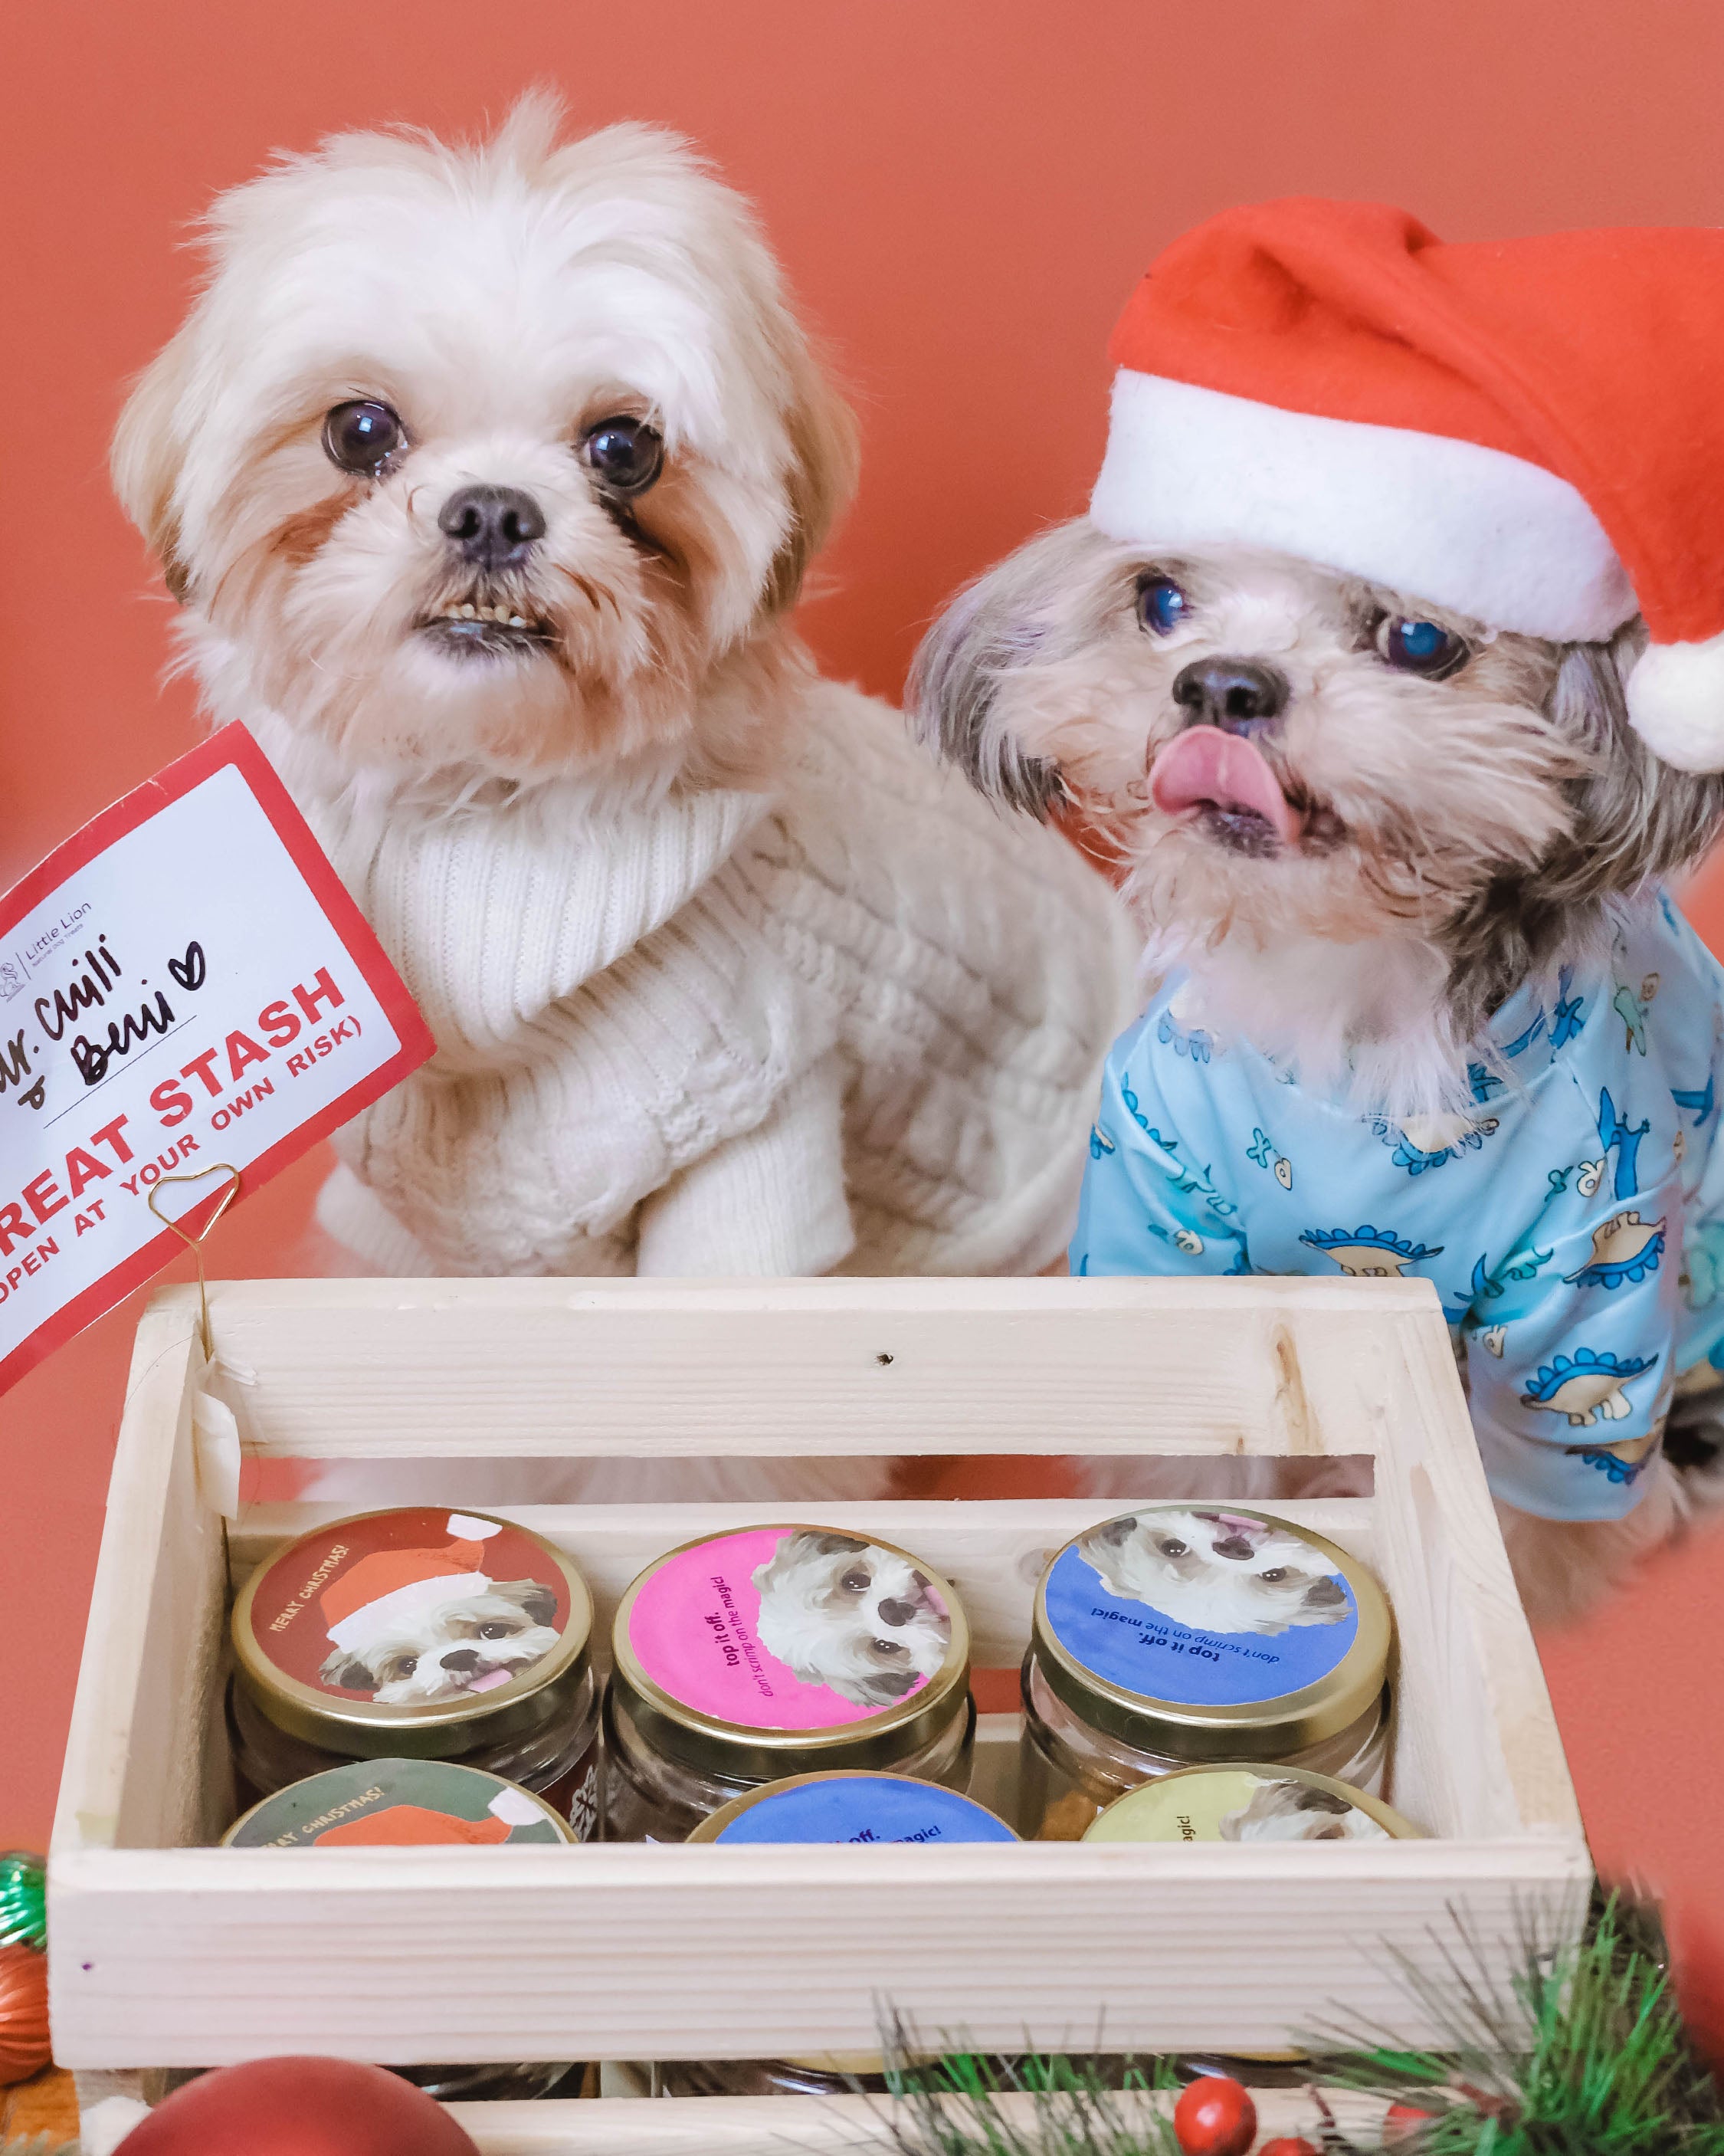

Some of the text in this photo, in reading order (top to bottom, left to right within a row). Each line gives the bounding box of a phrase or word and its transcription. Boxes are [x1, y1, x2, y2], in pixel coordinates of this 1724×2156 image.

[25, 903, 91, 960] Little Lion
[149, 966, 345, 1127] STASH
[74, 1198, 106, 1237] AT
[120, 1134, 201, 1196] YOUR
[211, 1076, 275, 1131] OWN
[286, 1008, 362, 1078] RISK)
[269, 1544, 349, 1632] MERRY CHRISTMAS!
[704, 1612, 740, 1667] top it off.
[710, 1576, 774, 1697] don't scrimp on the magic!
[1090, 1608, 1280, 1665] don't scrimp on the magic!
[1139, 1633, 1221, 1662] top it off.
[302, 1786, 385, 1834] CHRISTMAS!
[889, 1826, 942, 1843] agic!
